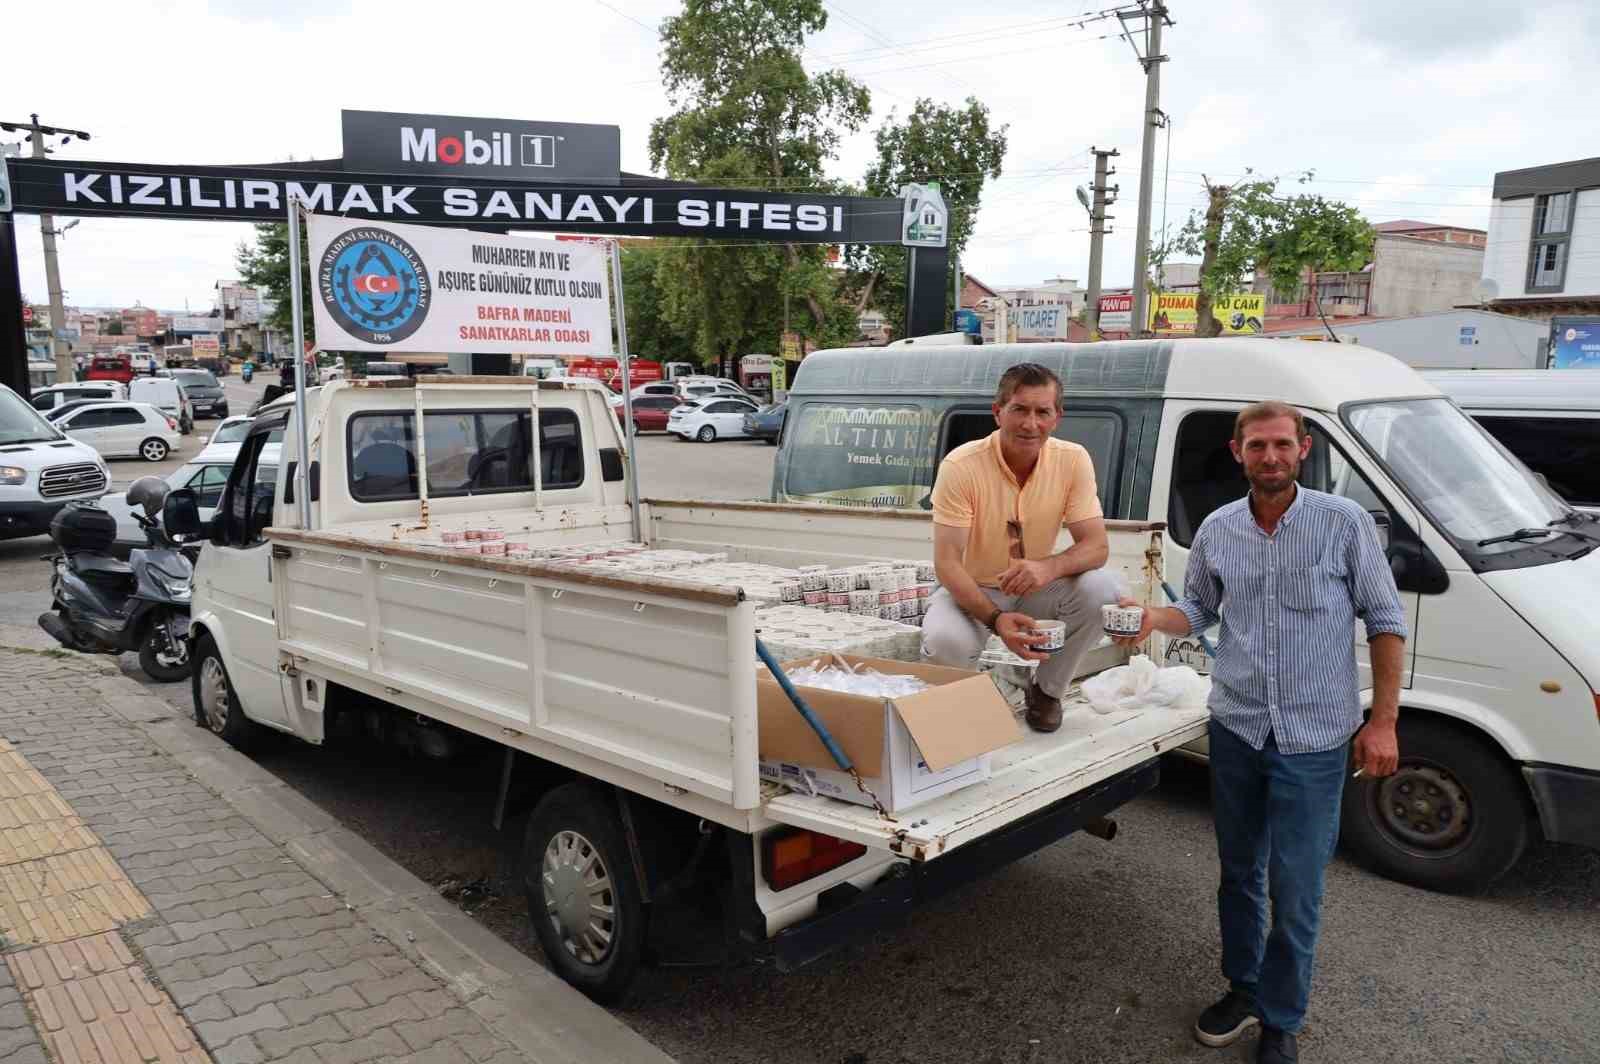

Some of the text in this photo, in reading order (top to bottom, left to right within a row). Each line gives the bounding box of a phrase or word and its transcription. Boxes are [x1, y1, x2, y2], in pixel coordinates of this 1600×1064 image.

[401, 127, 511, 167] Mobil
[63, 172, 843, 232] KIZILIRMAK SANAYI SITESI
[472, 244, 570, 271] MUHARREM AYI VE
[438, 270, 602, 299] AŞURE GÜNÜNÜZ KUTLU OLSUN
[477, 305, 572, 324] BAFRA MADENİ
[1233, 298, 1259, 310] CAM
[459, 325, 590, 343] SANATKARLAR ODASI
[847, 452, 882, 465] Yemek
